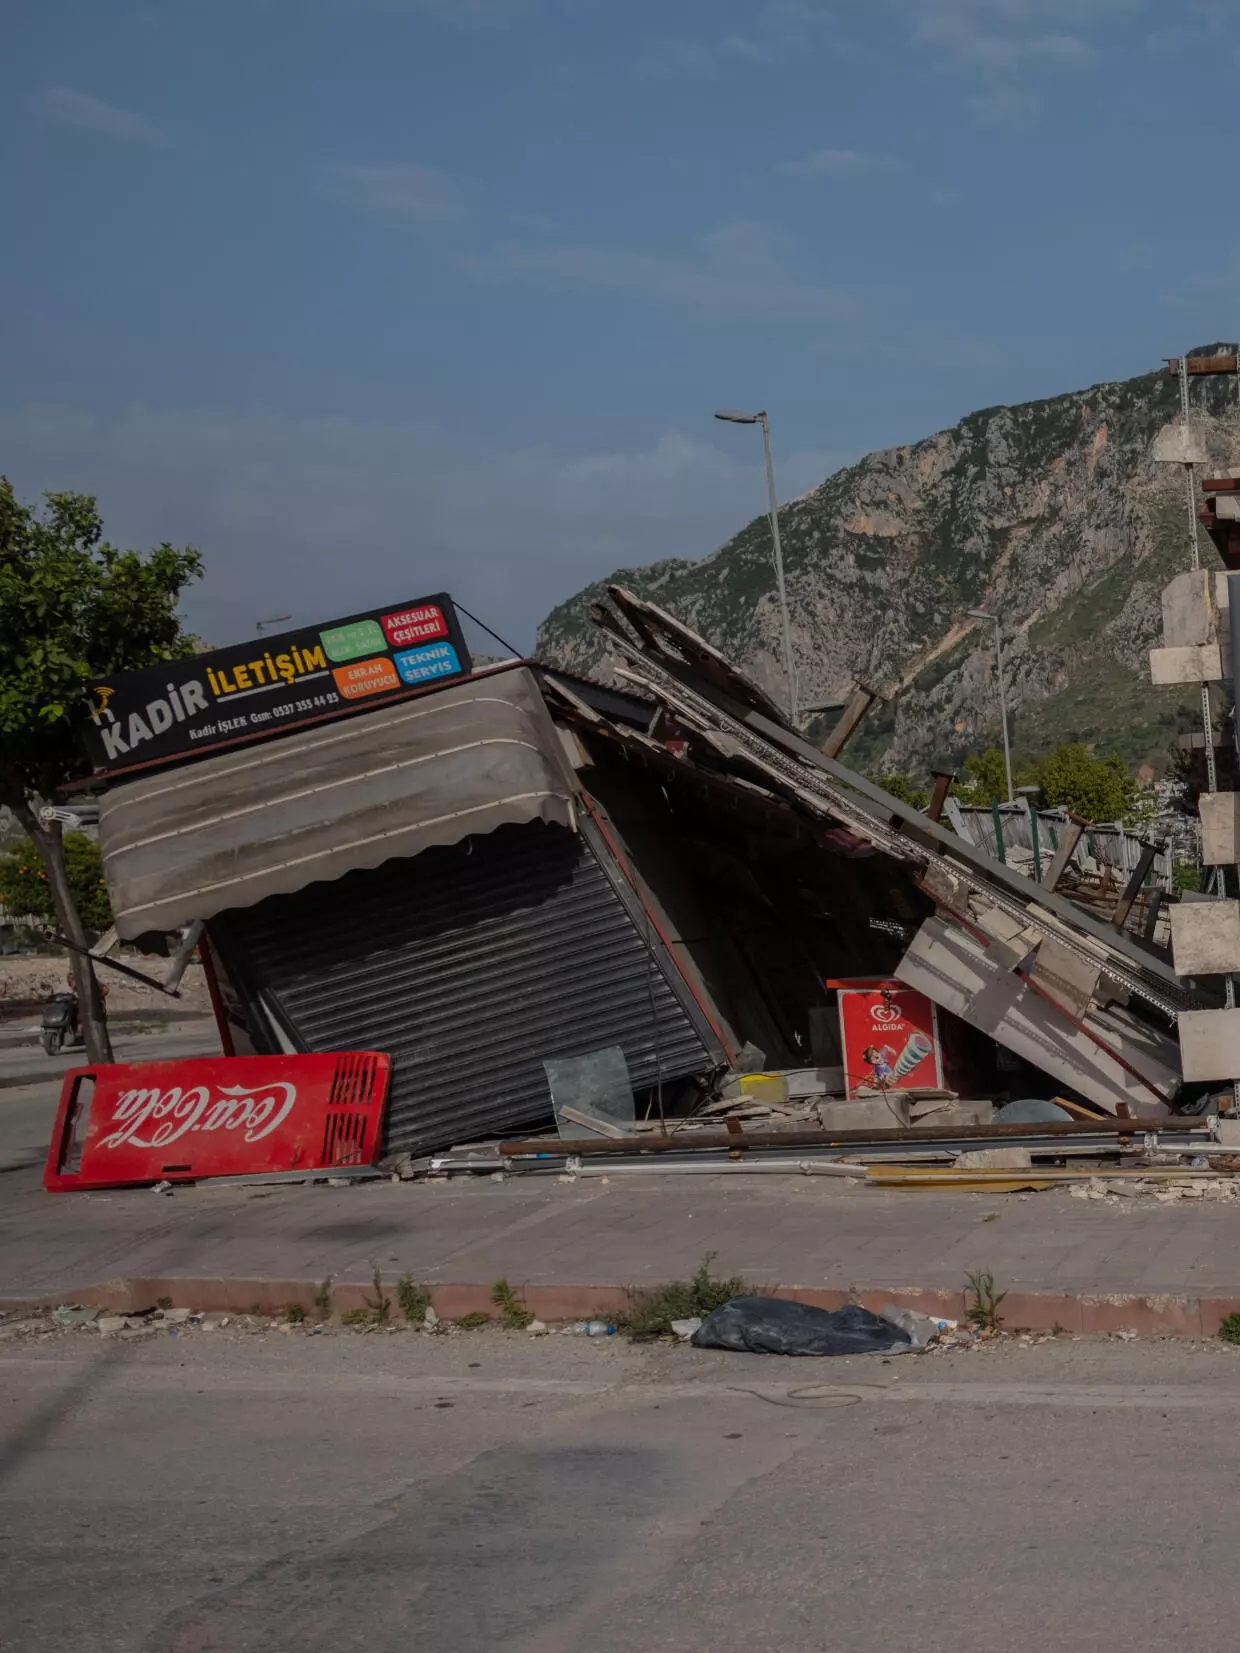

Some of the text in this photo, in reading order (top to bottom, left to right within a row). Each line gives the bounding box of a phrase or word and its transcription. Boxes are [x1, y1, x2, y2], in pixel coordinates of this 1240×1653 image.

[387, 607, 439, 630] AKSESUAR
[343, 674, 398, 696] KORUYUCU
[100, 645, 328, 760] KADİR İLETİŞİM
[188, 724, 217, 740] Kadir
[250, 711, 273, 724] Gsm:
[272, 703, 295, 718] 0537
[296, 699, 313, 712] 355
[872, 1023, 903, 1031] ALGIDA
